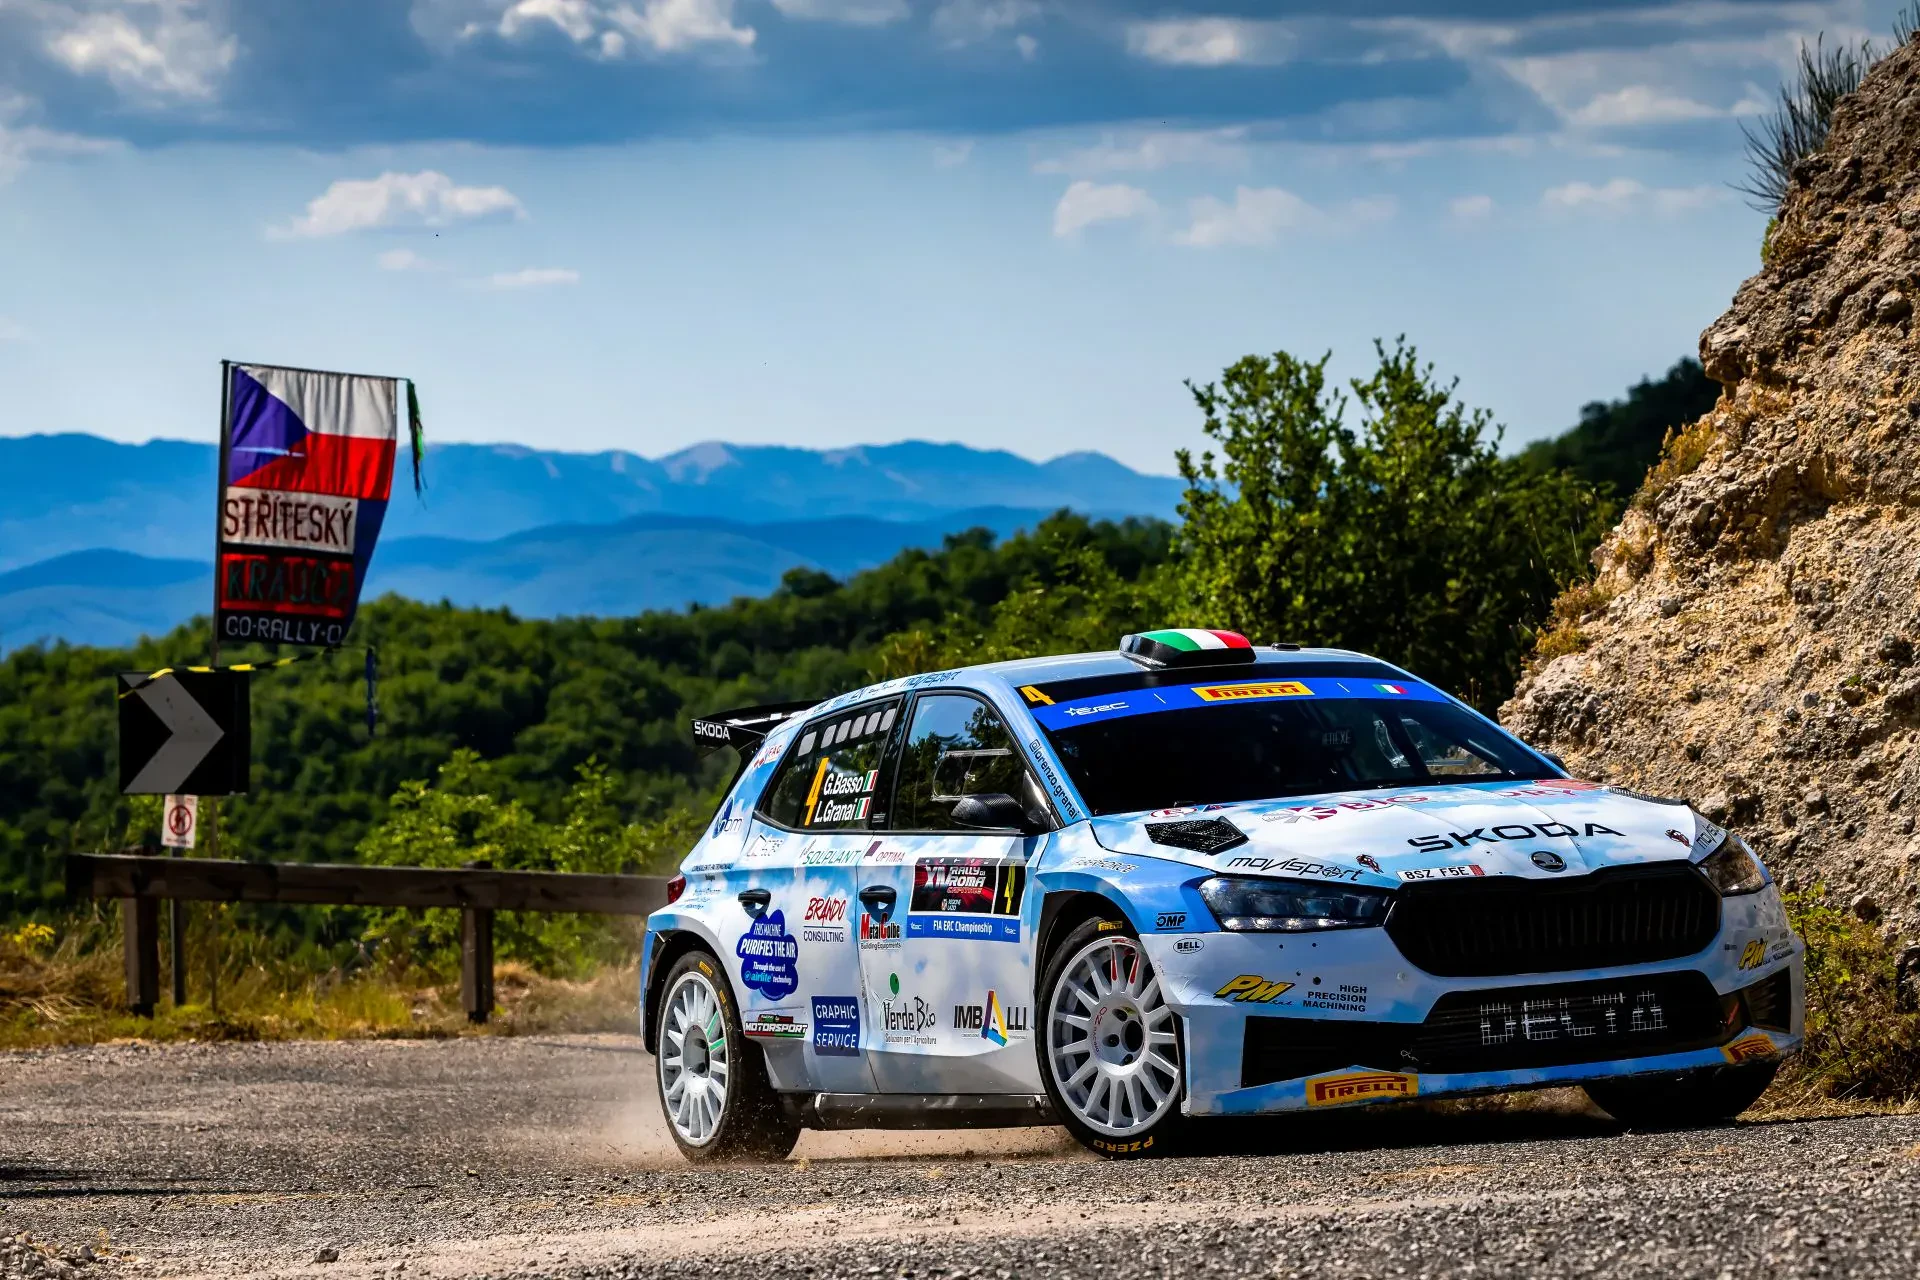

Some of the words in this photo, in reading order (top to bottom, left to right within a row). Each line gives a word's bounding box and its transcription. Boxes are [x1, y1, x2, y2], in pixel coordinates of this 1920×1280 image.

[1020, 685, 1056, 706] 4
[1205, 684, 1300, 698] PIRELLI
[823, 772, 864, 795] G.Basso
[1029, 739, 1080, 820] @lorenzo.granai
[804, 757, 830, 827] 4
[814, 798, 858, 822] L.Granai
[802, 850, 861, 865] SOLPLANT
[950, 866, 980, 875] RALLY
[1227, 857, 1365, 881] movisport
[1405, 869, 1434, 880] 8SZ
[1440, 866, 1470, 877] F5E
[948, 877, 986, 887] ROMA
[805, 897, 846, 925] BRANDO
[933, 920, 943, 931] FIA
[943, 920, 955, 932] ERC
[955, 921, 993, 935] Championship
[1156, 915, 1186, 927] OMP
[803, 931, 844, 942] CONSULTING
[740, 938, 773, 956] PURIFIES
[774, 941, 785, 957] THE
[785, 942, 796, 958] AIR
[1176, 941, 1201, 950] BELL
[753, 961, 769, 972] Through
[1339, 985, 1367, 993] HIGH
[1307, 991, 1367, 1003] PRECISION
[816, 1004, 857, 1019] GRAPHIC
[1303, 1000, 1366, 1012] MACHINING
[883, 1001, 915, 1030] Verde
[914, 996, 936, 1033] Bio
[745, 1022, 808, 1033] MOTORSPORT
[816, 1034, 857, 1048] SERVICE
[1314, 1075, 1409, 1101] PIRELLI
